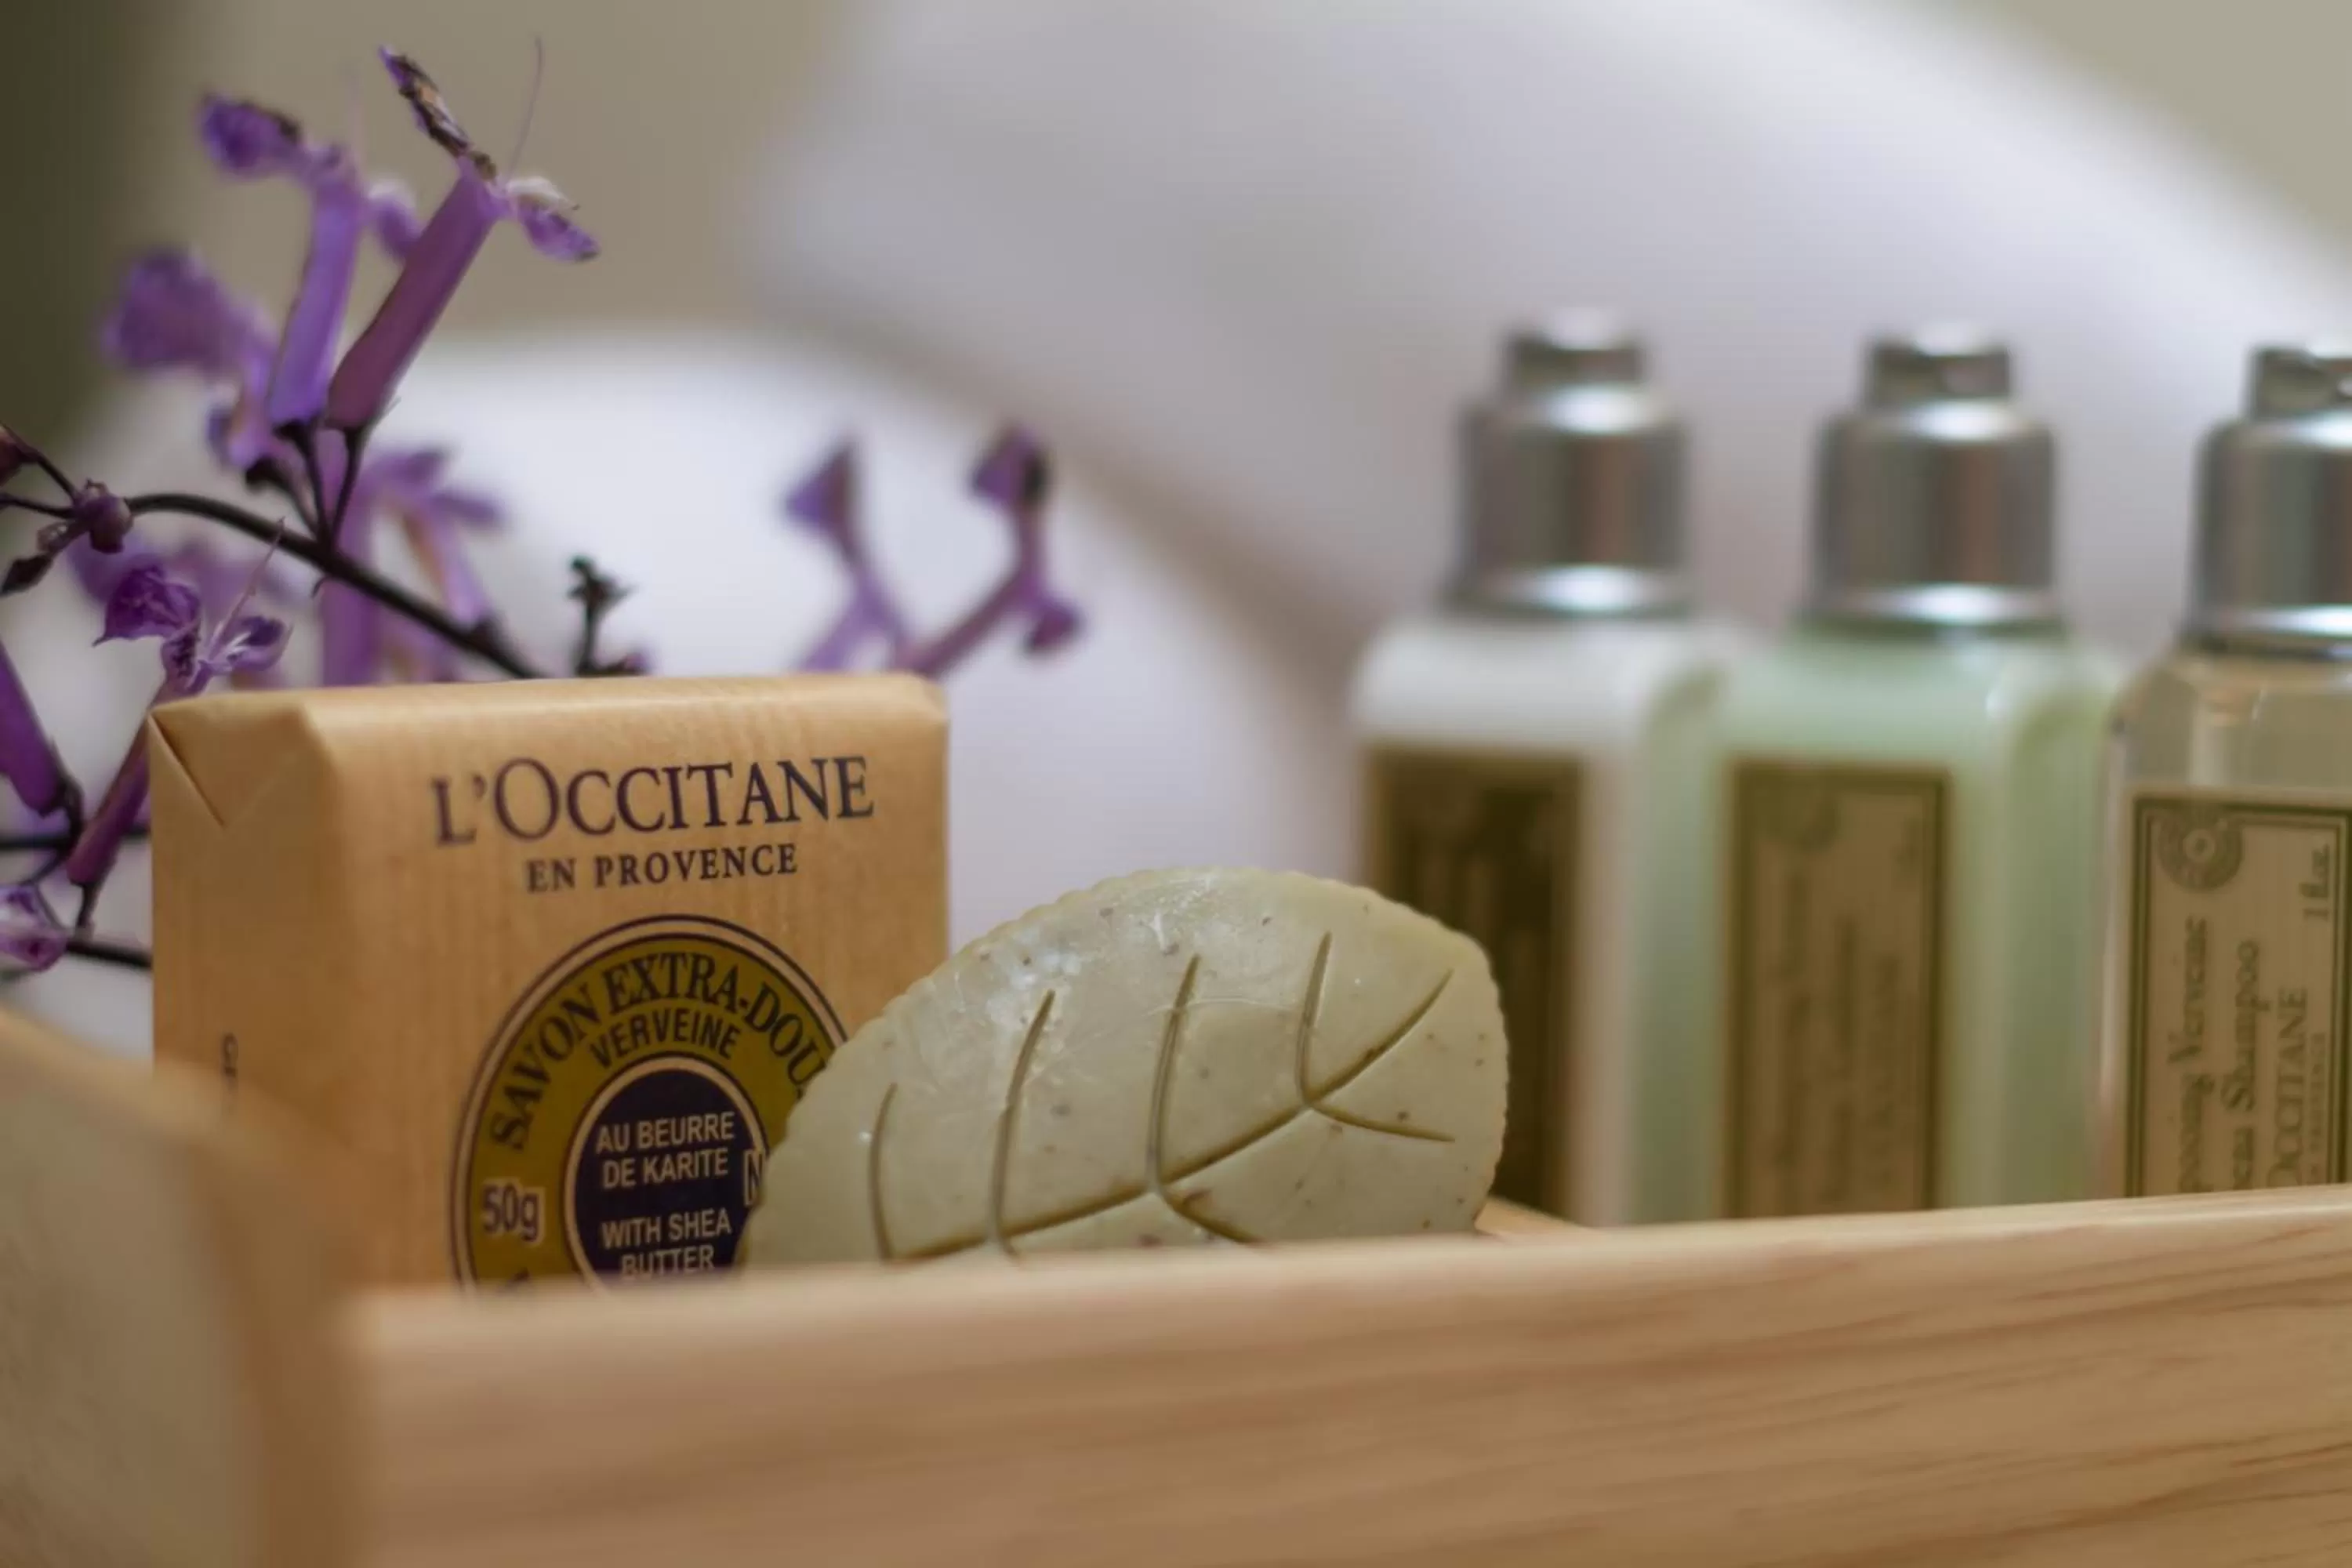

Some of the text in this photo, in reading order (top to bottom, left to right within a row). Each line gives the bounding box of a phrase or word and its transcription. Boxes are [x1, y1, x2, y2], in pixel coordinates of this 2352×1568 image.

[430, 756, 873, 846] L'OCCITANE
[527, 843, 798, 893] EN PROVENCE
[489, 951, 828, 1152] SAVON EXTRA-DOU
[590, 1007, 741, 1069] VERVEINE
[596, 1112, 735, 1155] AU BEURRE
[602, 1147, 729, 1190] DE KARITE
[481, 1181, 540, 1243] 50g
[601, 1208, 732, 1250] WITH SHEA
[621, 1243, 716, 1281] BUTTER
